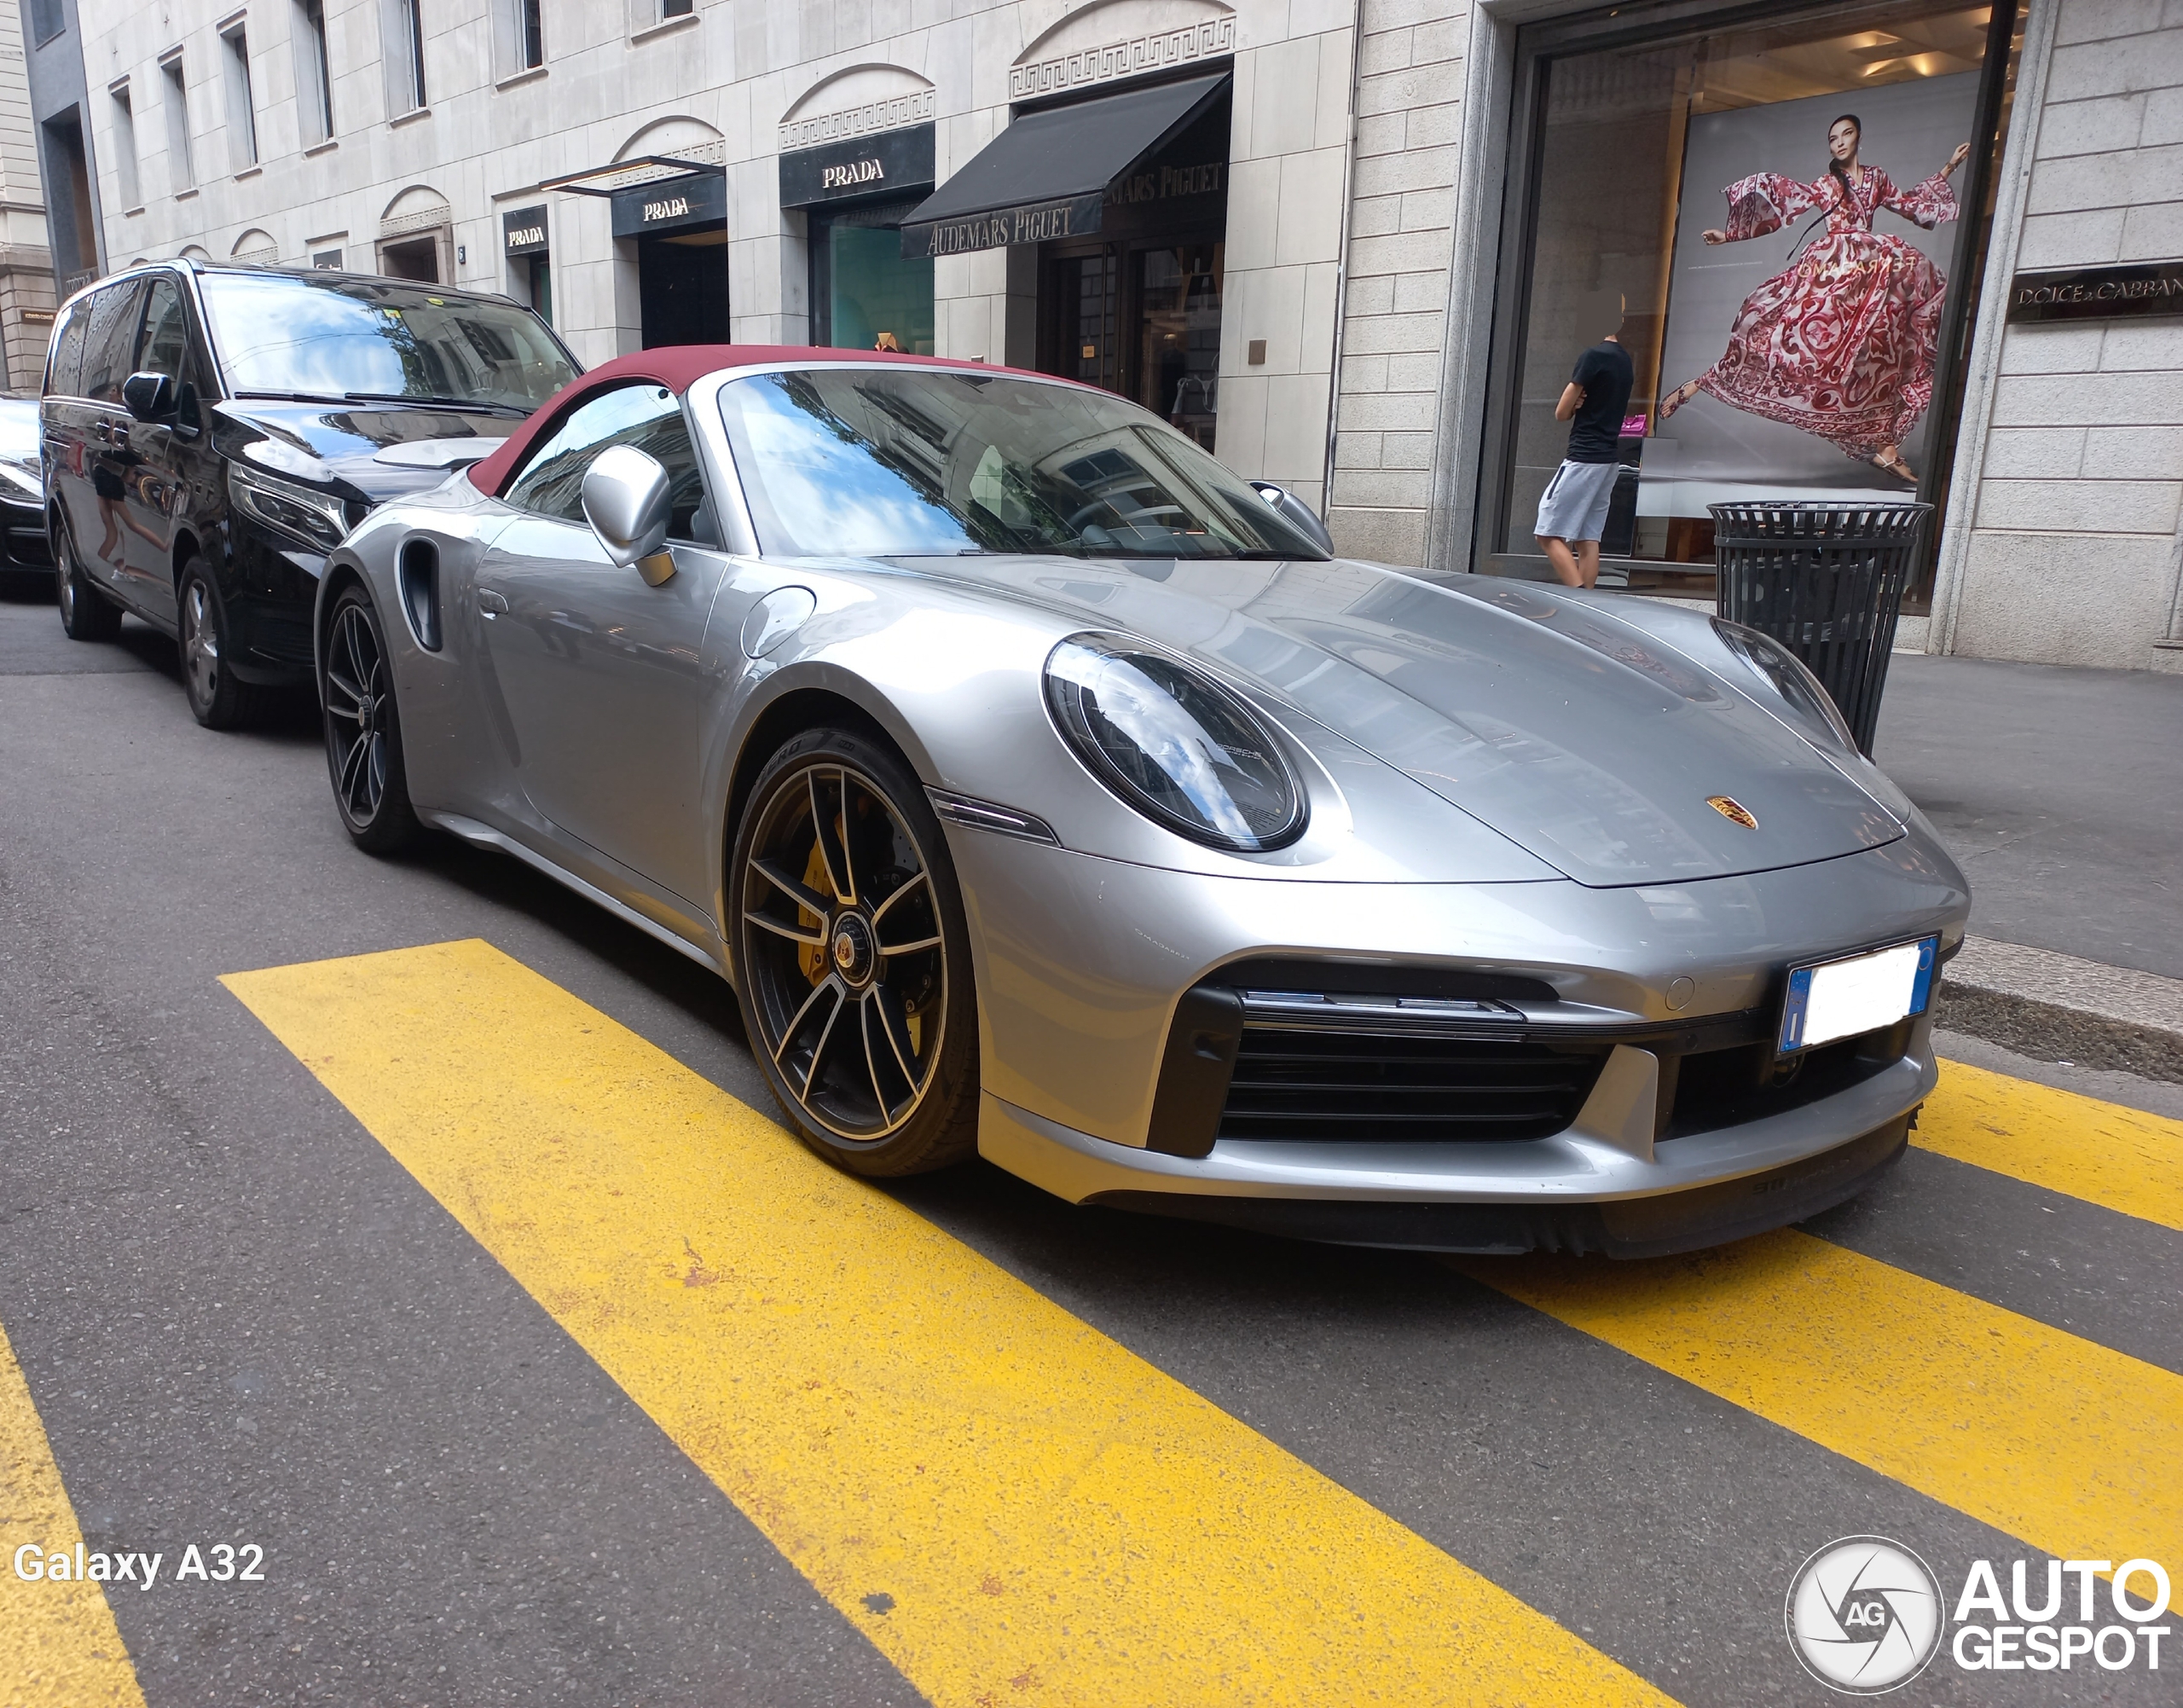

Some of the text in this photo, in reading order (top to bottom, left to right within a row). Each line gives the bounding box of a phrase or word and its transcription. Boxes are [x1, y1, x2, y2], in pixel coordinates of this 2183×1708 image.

[822, 159, 884, 188] PRADA
[1160, 162, 1223, 199] PIGUET
[643, 197, 689, 222] PRADA
[508, 226, 544, 247] PRADA
[927, 206, 1072, 255] AUDEMARS PIGUET
[1216, 743, 1262, 758] PORSCHE
